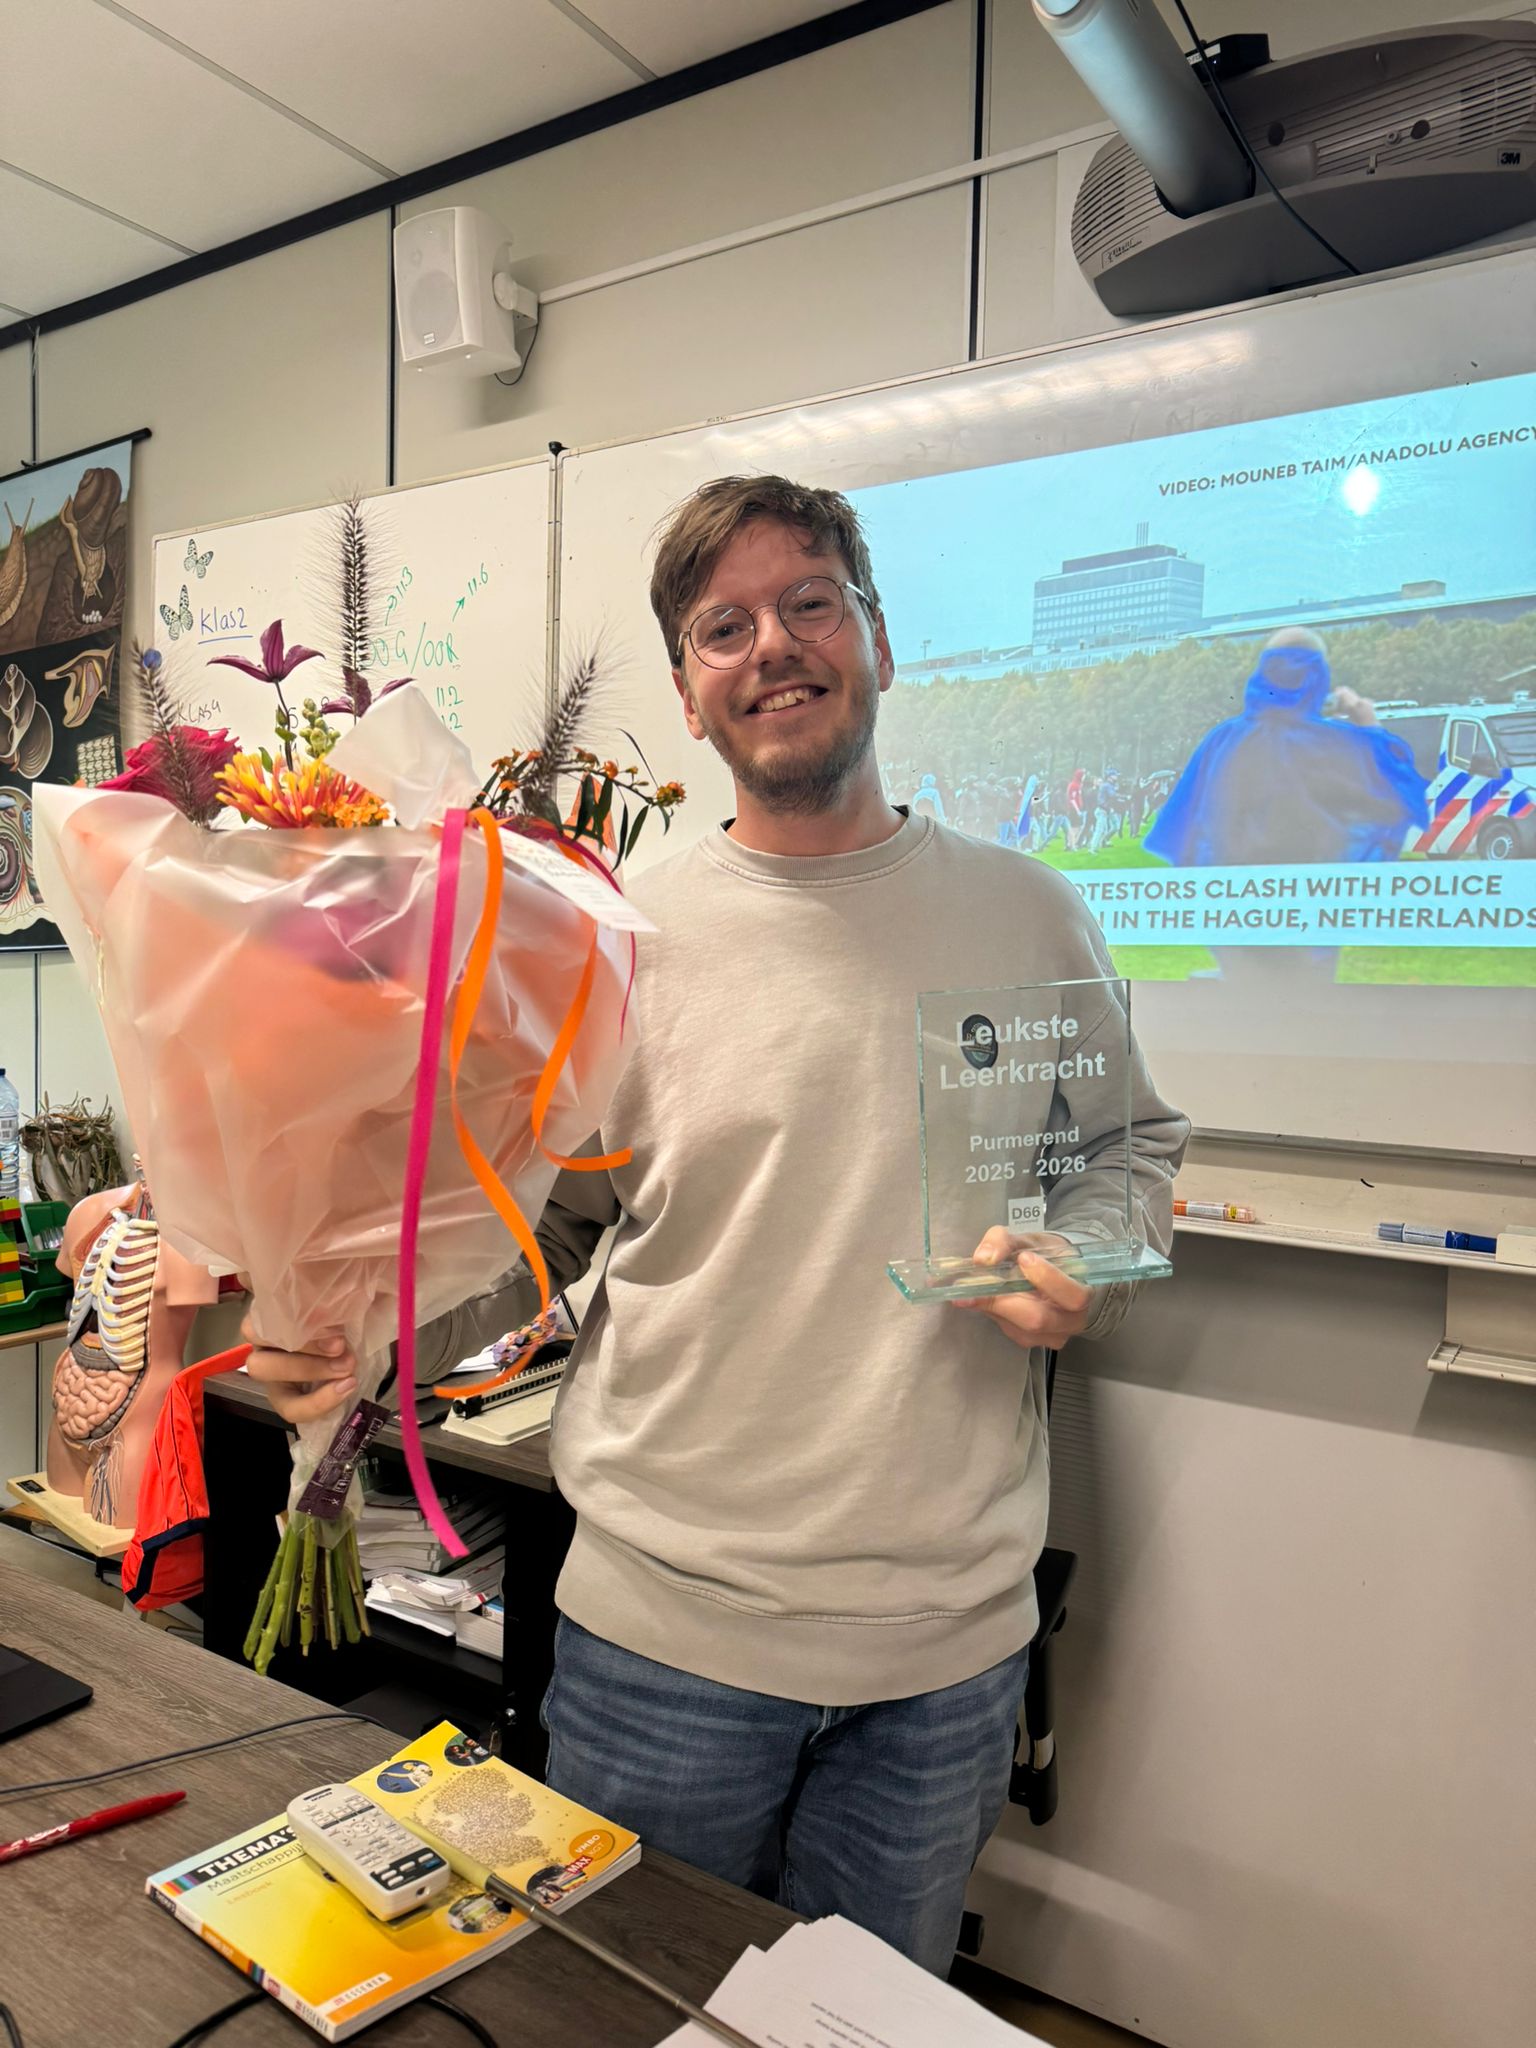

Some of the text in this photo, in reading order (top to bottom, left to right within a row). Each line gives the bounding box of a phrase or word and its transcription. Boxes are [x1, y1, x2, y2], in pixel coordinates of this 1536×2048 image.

[1501, 152, 1521, 165] 3M
[1158, 475, 1216, 497] VIDEO:
[1220, 463, 1297, 488] MOUNEB
[1302, 438, 1452, 476] TAIM/ANADOLU
[467, 562, 489, 596] 11.6
[436, 685, 464, 707] 11.2
[1205, 879, 1298, 899] CLASH
[1306, 877, 1381, 897] WITH
[1391, 875, 1503, 897] POLICE
[1112, 911, 1139, 929] IN
[1146, 910, 1196, 929] THE
[1203, 909, 1309, 932] HAGUE,
[956, 1013, 1079, 1048] Leukste
[940, 1051, 1106, 1090] Leerkracht
[969, 1126, 1080, 1152] Purmerend
[964, 1162, 1016, 1184] 2025
[1036, 1155, 1086, 1177] 2026
[1012, 1205, 1041, 1220] D66
[575, 1834, 601, 1854] VMBO
[568, 1857, 591, 1874] MAX
